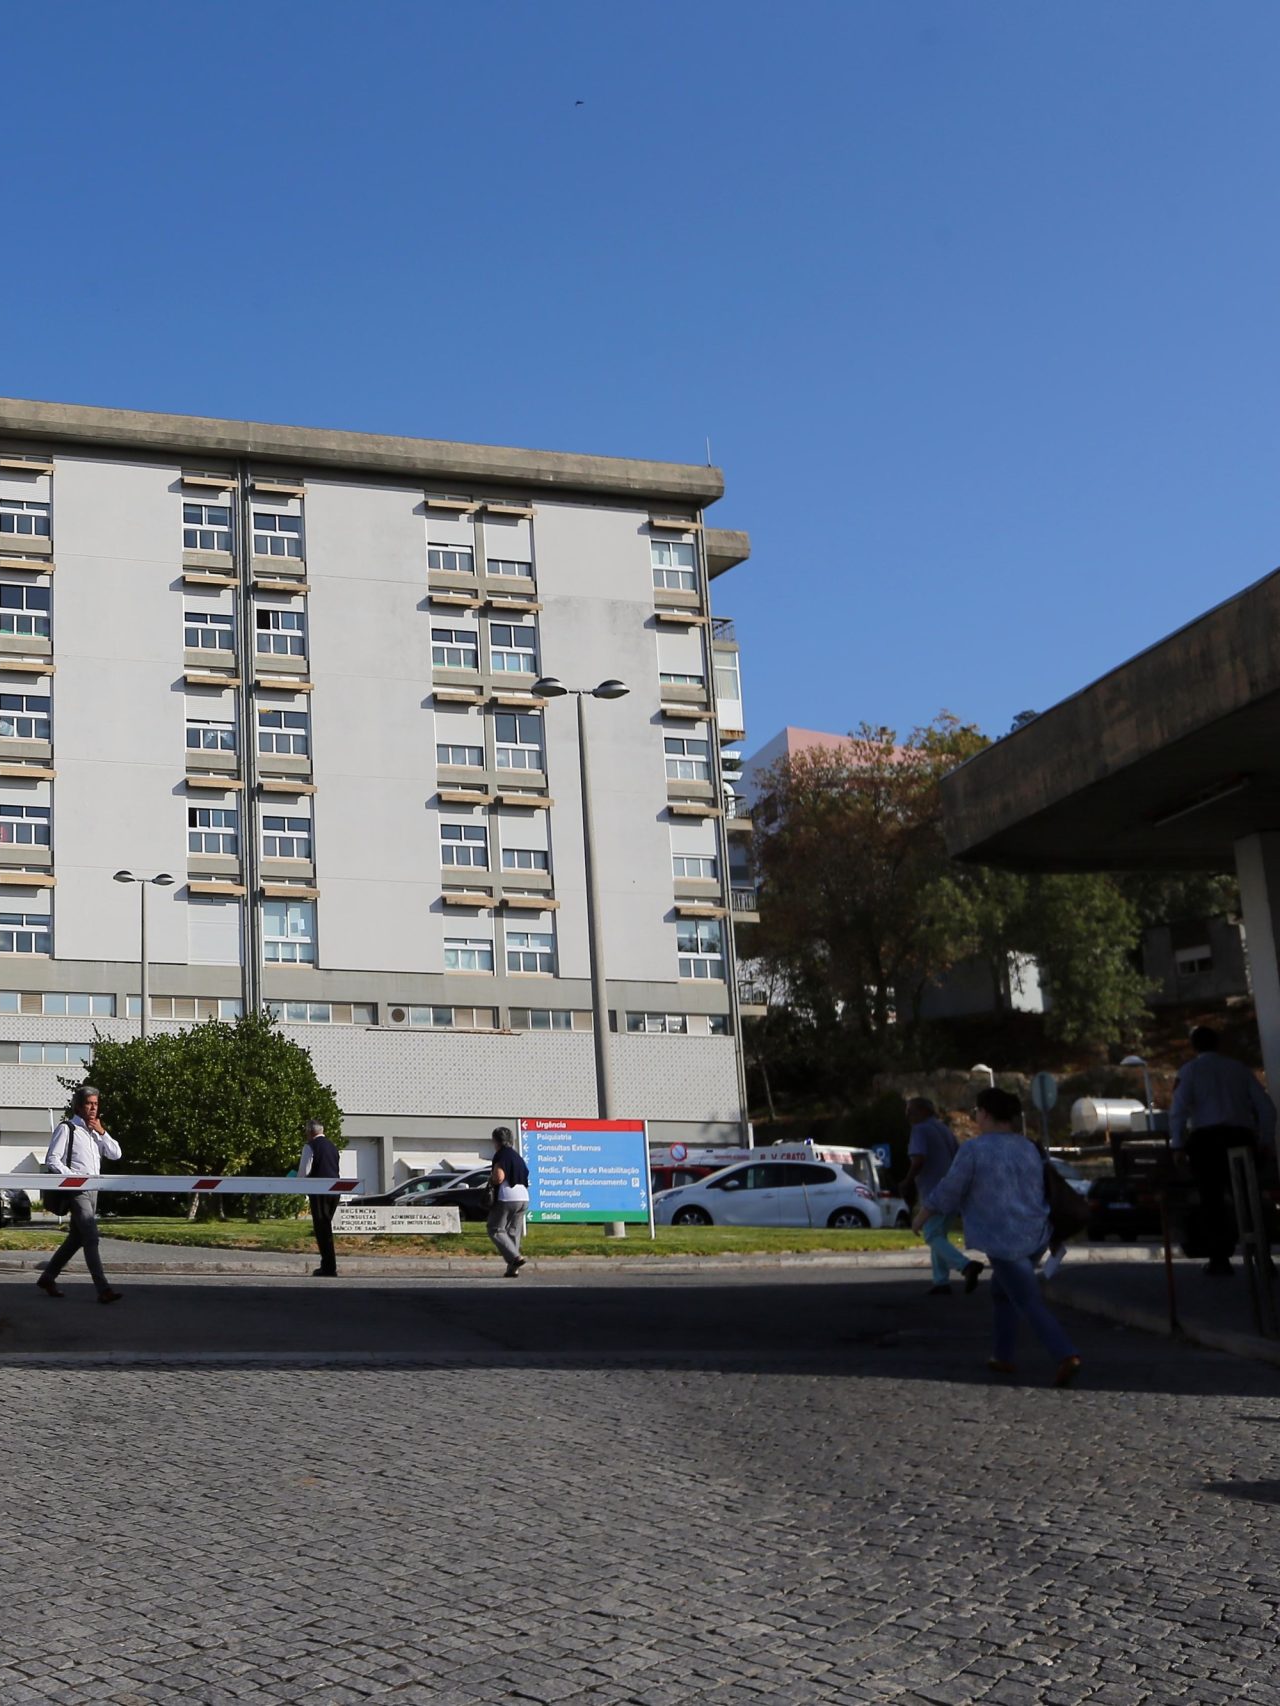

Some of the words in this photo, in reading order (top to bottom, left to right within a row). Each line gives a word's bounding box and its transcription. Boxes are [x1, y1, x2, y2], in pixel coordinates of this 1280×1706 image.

[536, 1120, 566, 1129] Urgência
[537, 1133, 572, 1142] Psiquiatria
[537, 1144, 570, 1152] Consultas
[572, 1144, 601, 1152] Externas
[599, 1166, 640, 1175] Reabilitação
[539, 1178, 563, 1187] Parque
[540, 1189, 581, 1198] Manutenção
[540, 1201, 590, 1209] Fornecimentos
[541, 1212, 561, 1220] Saída
